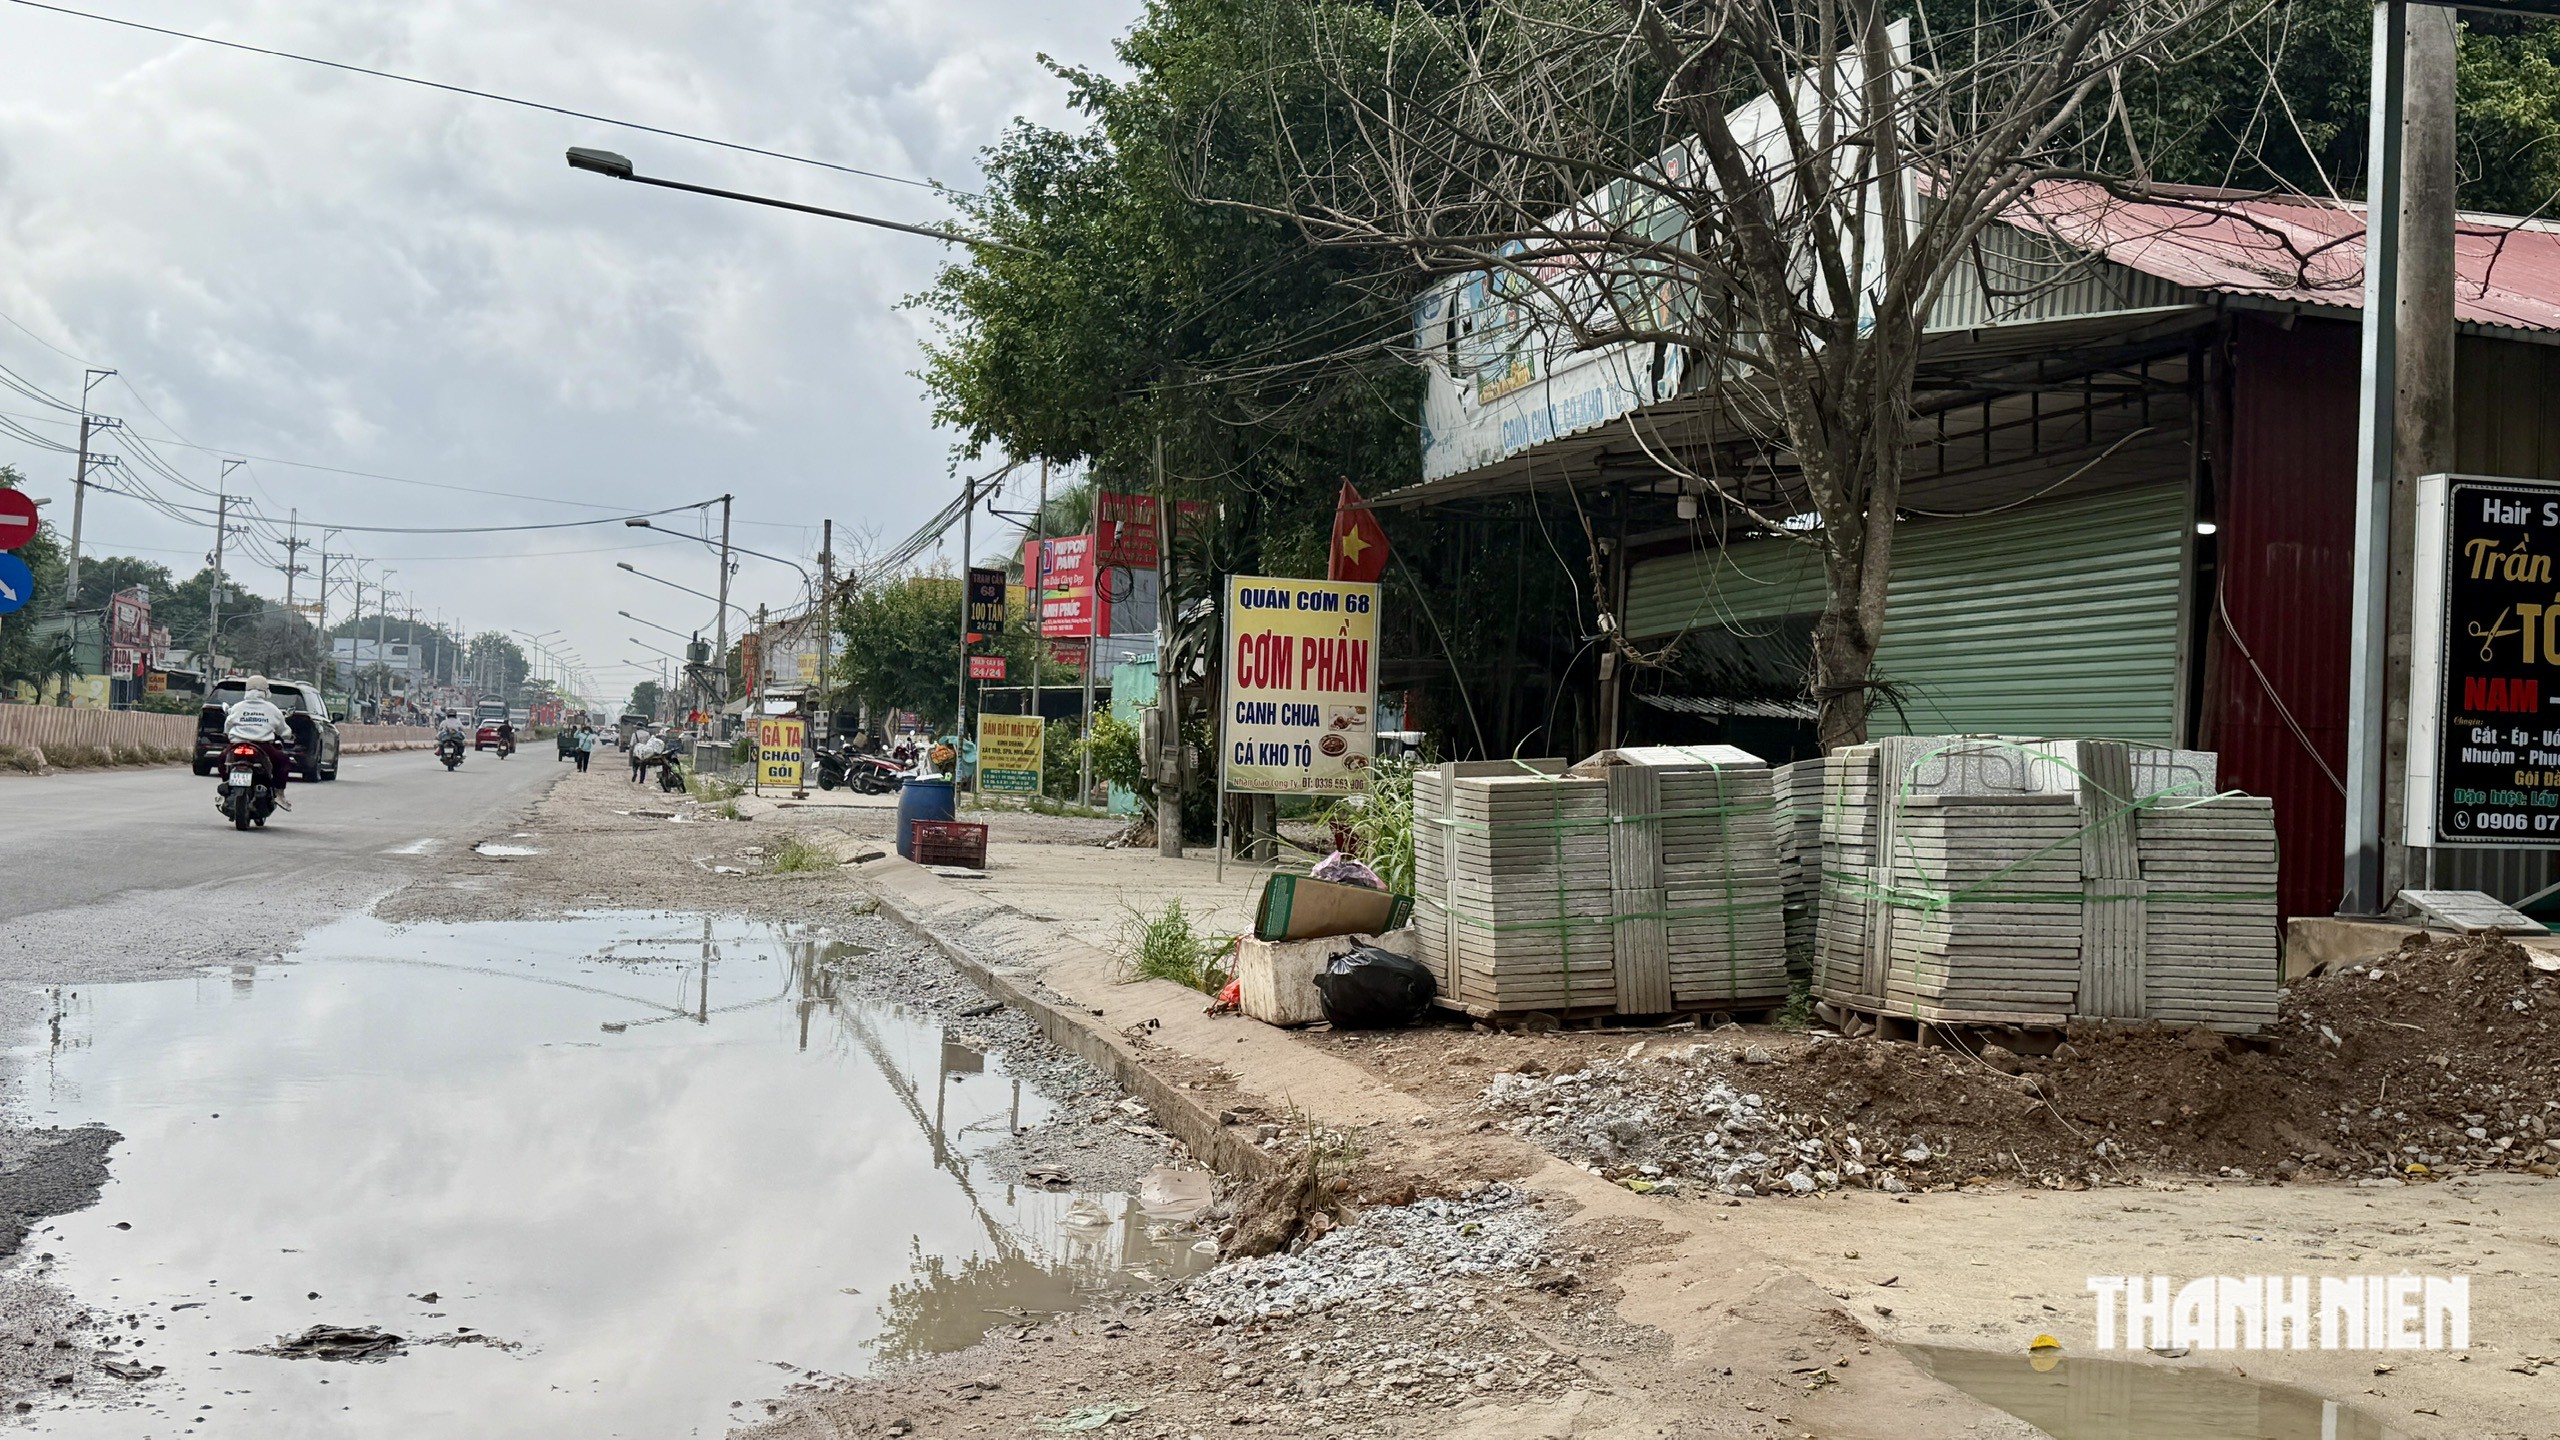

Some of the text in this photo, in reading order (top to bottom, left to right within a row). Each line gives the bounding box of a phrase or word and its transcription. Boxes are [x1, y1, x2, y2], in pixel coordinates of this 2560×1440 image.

[2483, 498, 2560, 527] Hair S
[1055, 539, 1088, 571] NIPPON PAINT
[2464, 532, 2552, 583] Trần
[980, 585, 996, 597] 68
[1239, 587, 1370, 614] QUÁN CƠM 68
[971, 597, 1003, 622] 100 TẤN
[1059, 599, 1080, 617] PHÚC
[976, 622, 997, 631] 24/24
[1237, 618, 1368, 693] CƠM PHẦN
[973, 667, 1001, 677] 24/24
[2464, 677, 2538, 713] NAM
[1236, 701, 1320, 727] CANH CHUA
[761, 722, 780, 747] GÀ
[785, 726, 801, 747] TA
[2471, 725, 2497, 744] Cắt
[2511, 727, 2529, 747] Ép
[761, 749, 800, 762] CHÁO
[1234, 737, 1312, 772] CÁ KHO TỘ
[2462, 747, 2515, 766] Nhuộm
[2529, 750, 2560, 768] Phụ
[2514, 770, 2539, 788] Gội
[2453, 788, 2558, 807] Đặc biệt: Lấy
[2476, 812, 2560, 831] 0906 07
